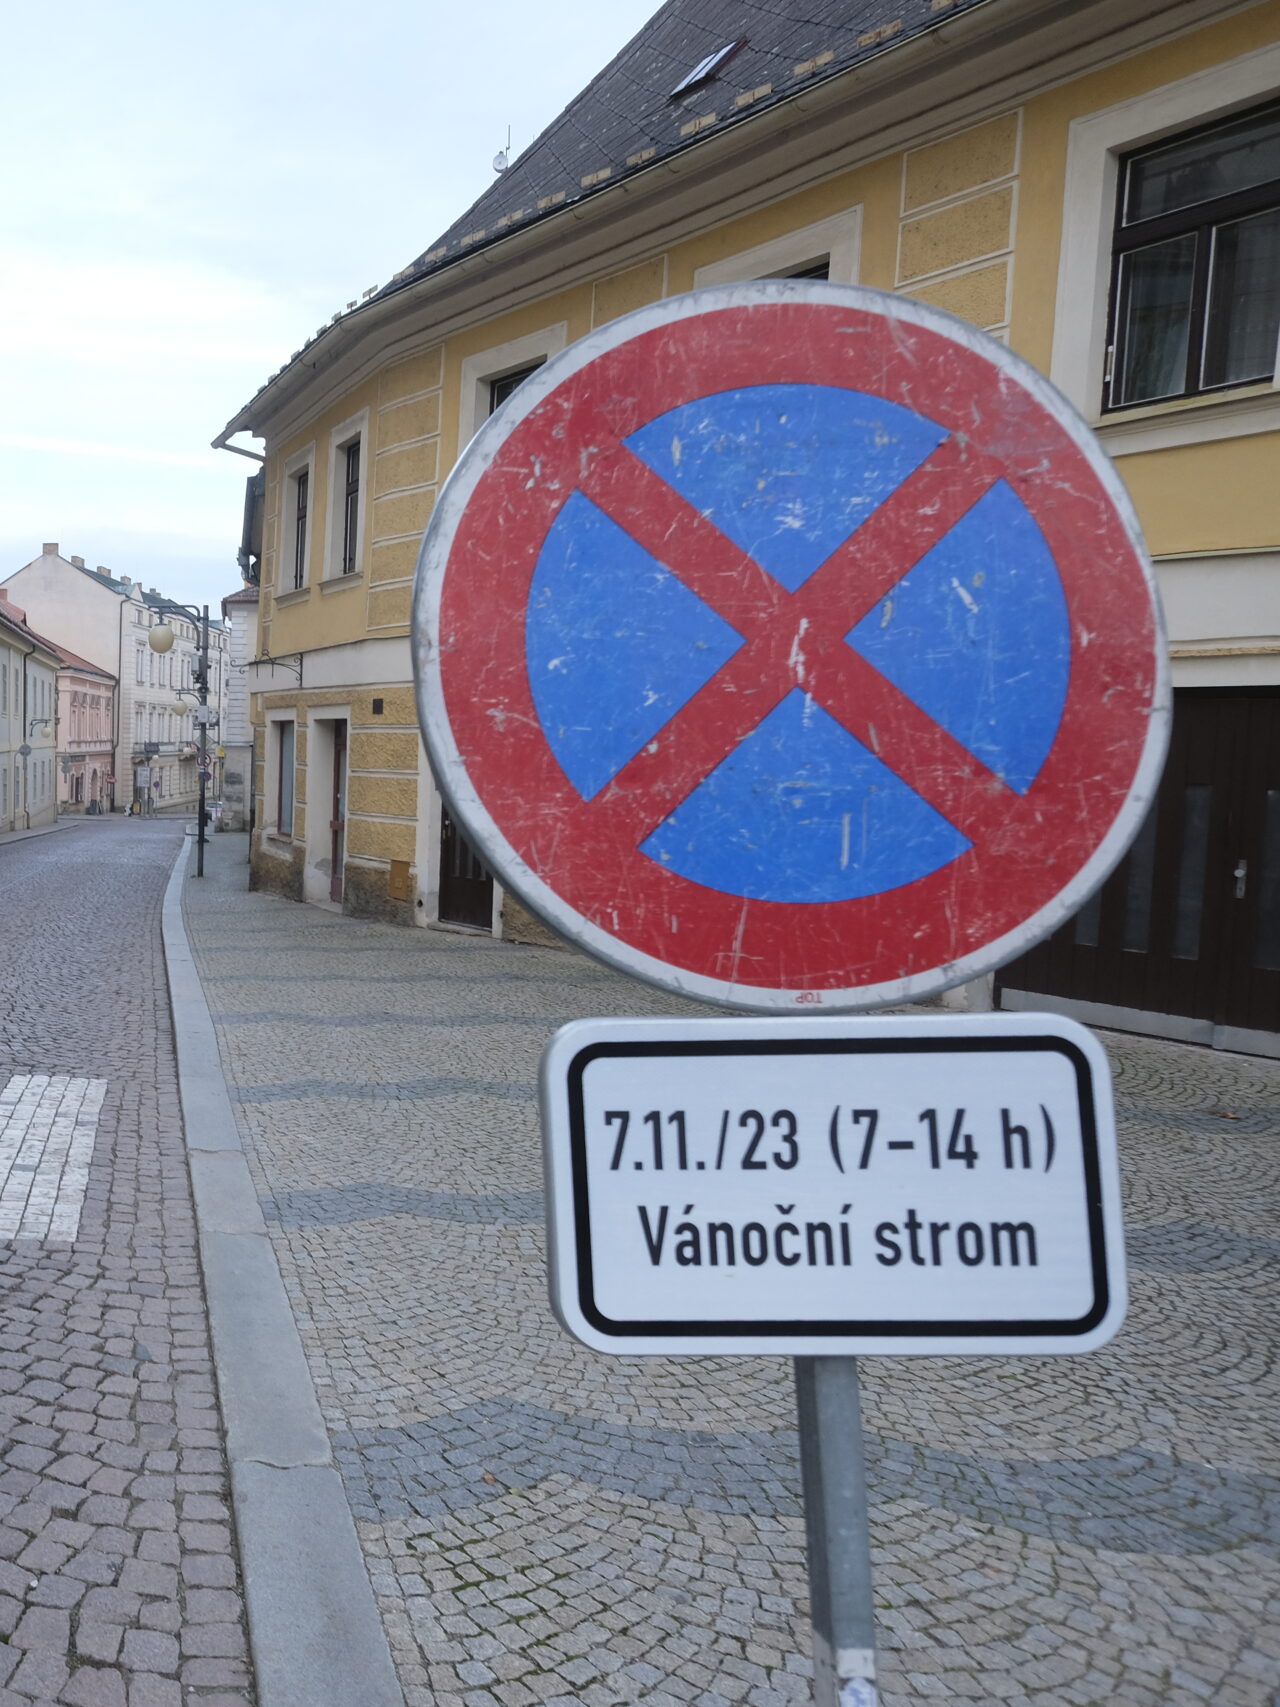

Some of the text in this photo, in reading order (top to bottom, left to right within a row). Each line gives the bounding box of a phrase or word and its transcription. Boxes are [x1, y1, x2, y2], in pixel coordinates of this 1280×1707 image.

[795, 991, 823, 1004] TOP
[603, 1104, 1057, 1174] 7.11./23 (7-14 h)
[637, 1203, 1038, 1267] Vánoční strom
